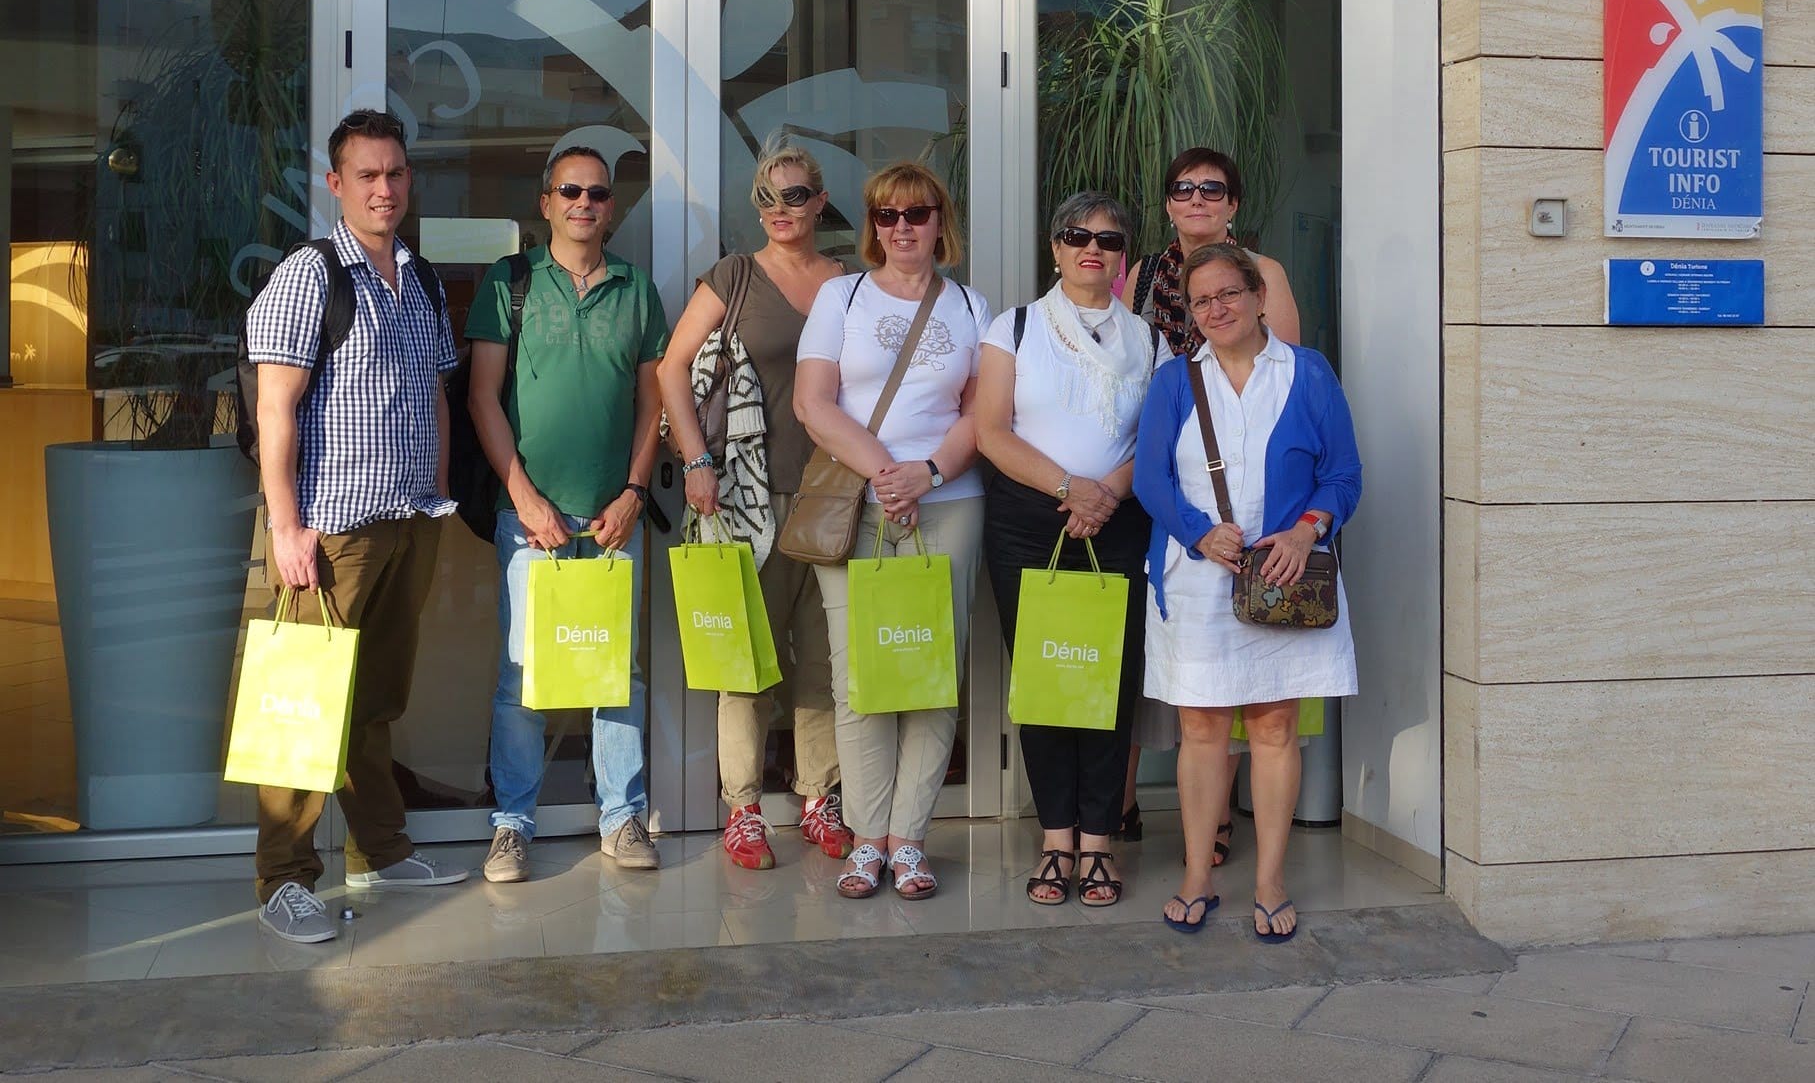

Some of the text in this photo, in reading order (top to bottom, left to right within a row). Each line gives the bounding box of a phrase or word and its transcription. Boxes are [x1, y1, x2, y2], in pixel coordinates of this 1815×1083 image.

[1648, 147, 1741, 169] TOURIST
[1669, 173, 1720, 194] INFO
[1672, 194, 1716, 210] DÉNIA
[692, 611, 733, 629] Dénia
[556, 625, 609, 643] Dénia
[878, 624, 933, 645] Dénia
[1042, 640, 1099, 662] Dénia
